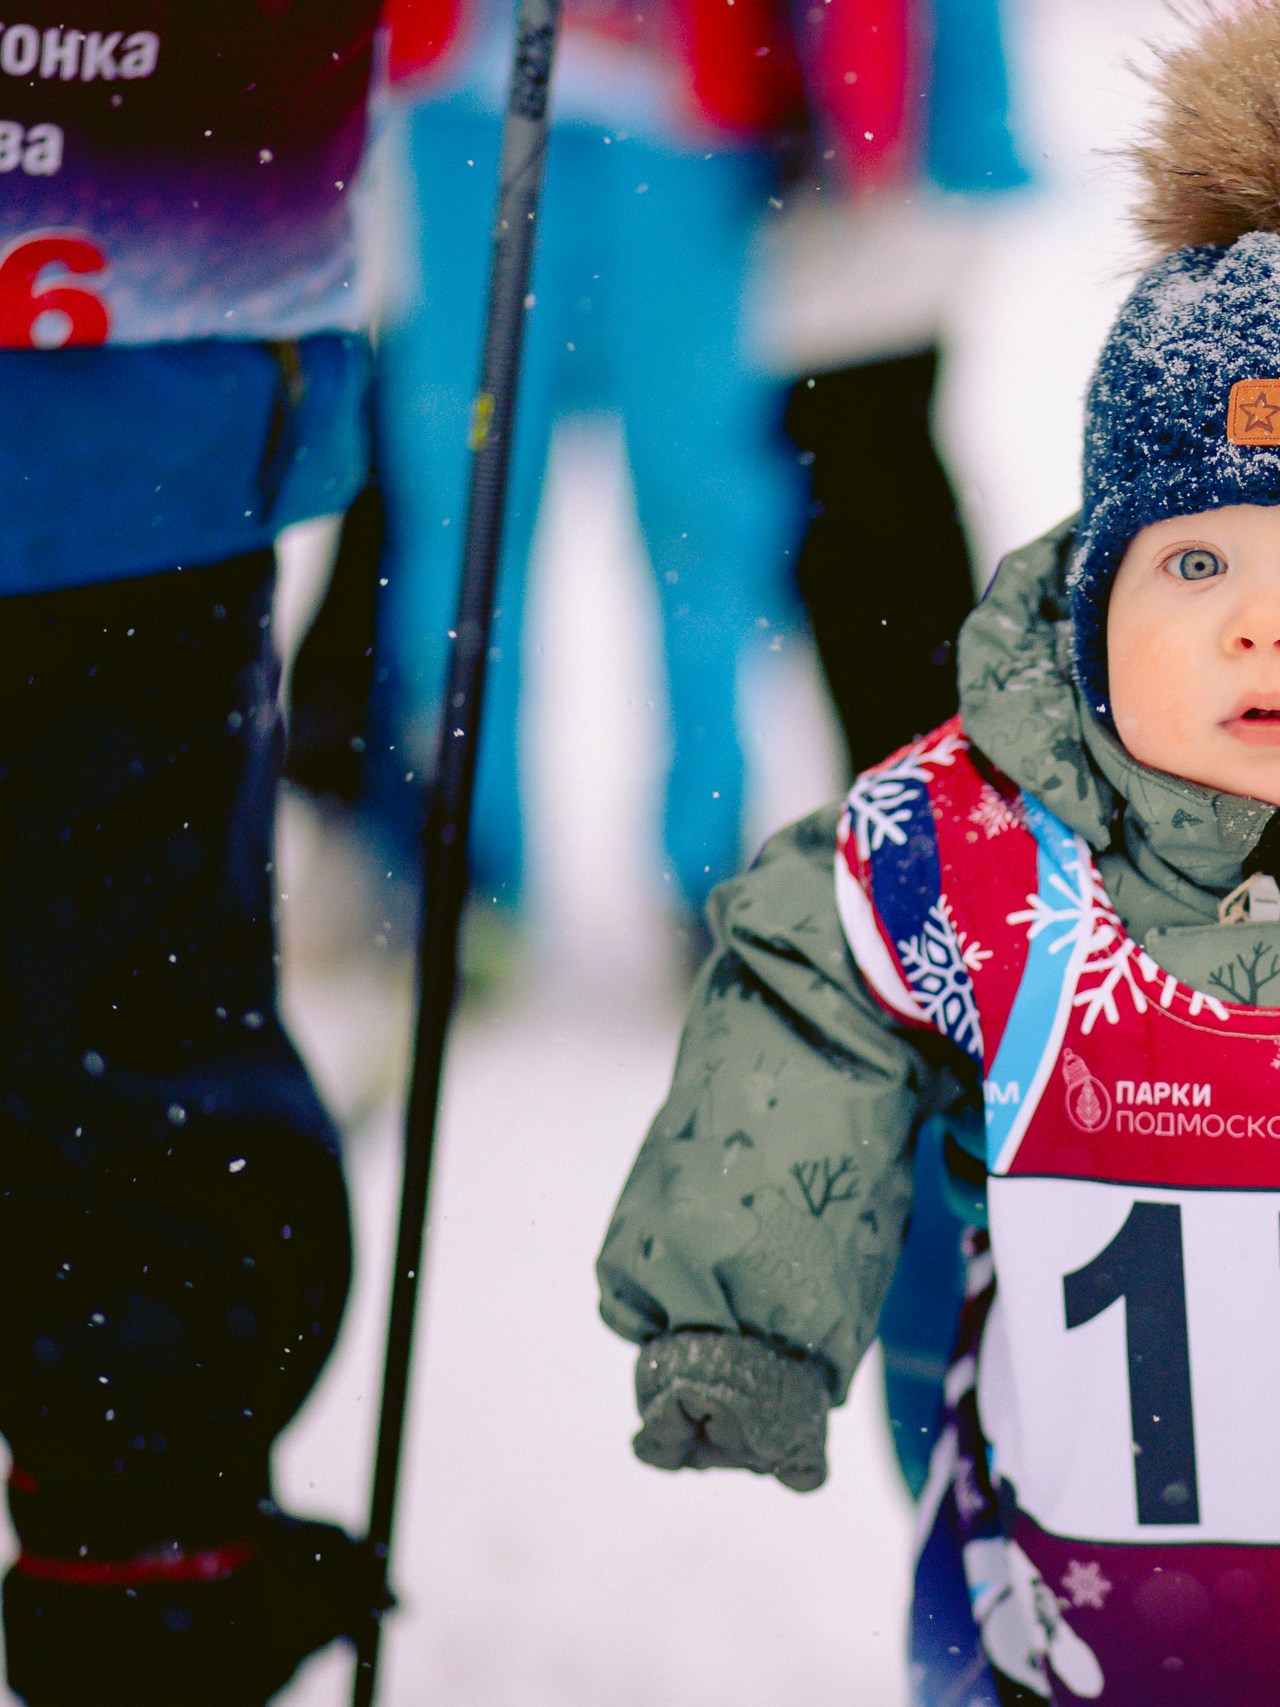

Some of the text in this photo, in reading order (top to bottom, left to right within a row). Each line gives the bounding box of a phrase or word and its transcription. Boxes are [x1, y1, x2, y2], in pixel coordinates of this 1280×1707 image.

[0, 22, 161, 82] онка
[0, 234, 109, 346] 6
[1115, 1080, 1212, 1108] ПАРКИ
